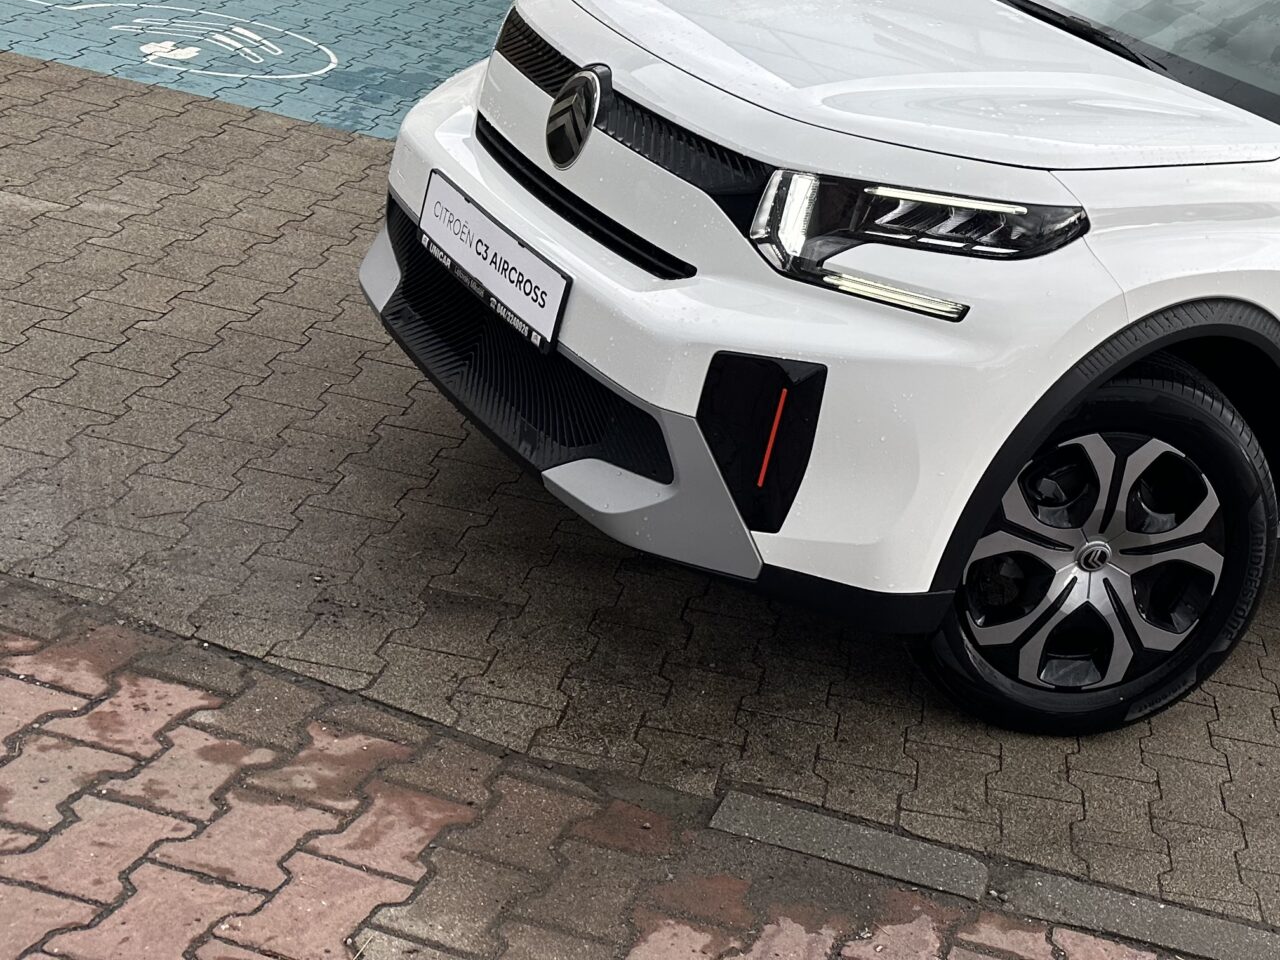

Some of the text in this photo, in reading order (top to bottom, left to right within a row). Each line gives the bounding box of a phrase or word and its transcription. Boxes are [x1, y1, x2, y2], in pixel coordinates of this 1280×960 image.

[429, 243, 451, 269] UNICAR
[433, 201, 547, 309] CITROËN C3 AIRCROSS
